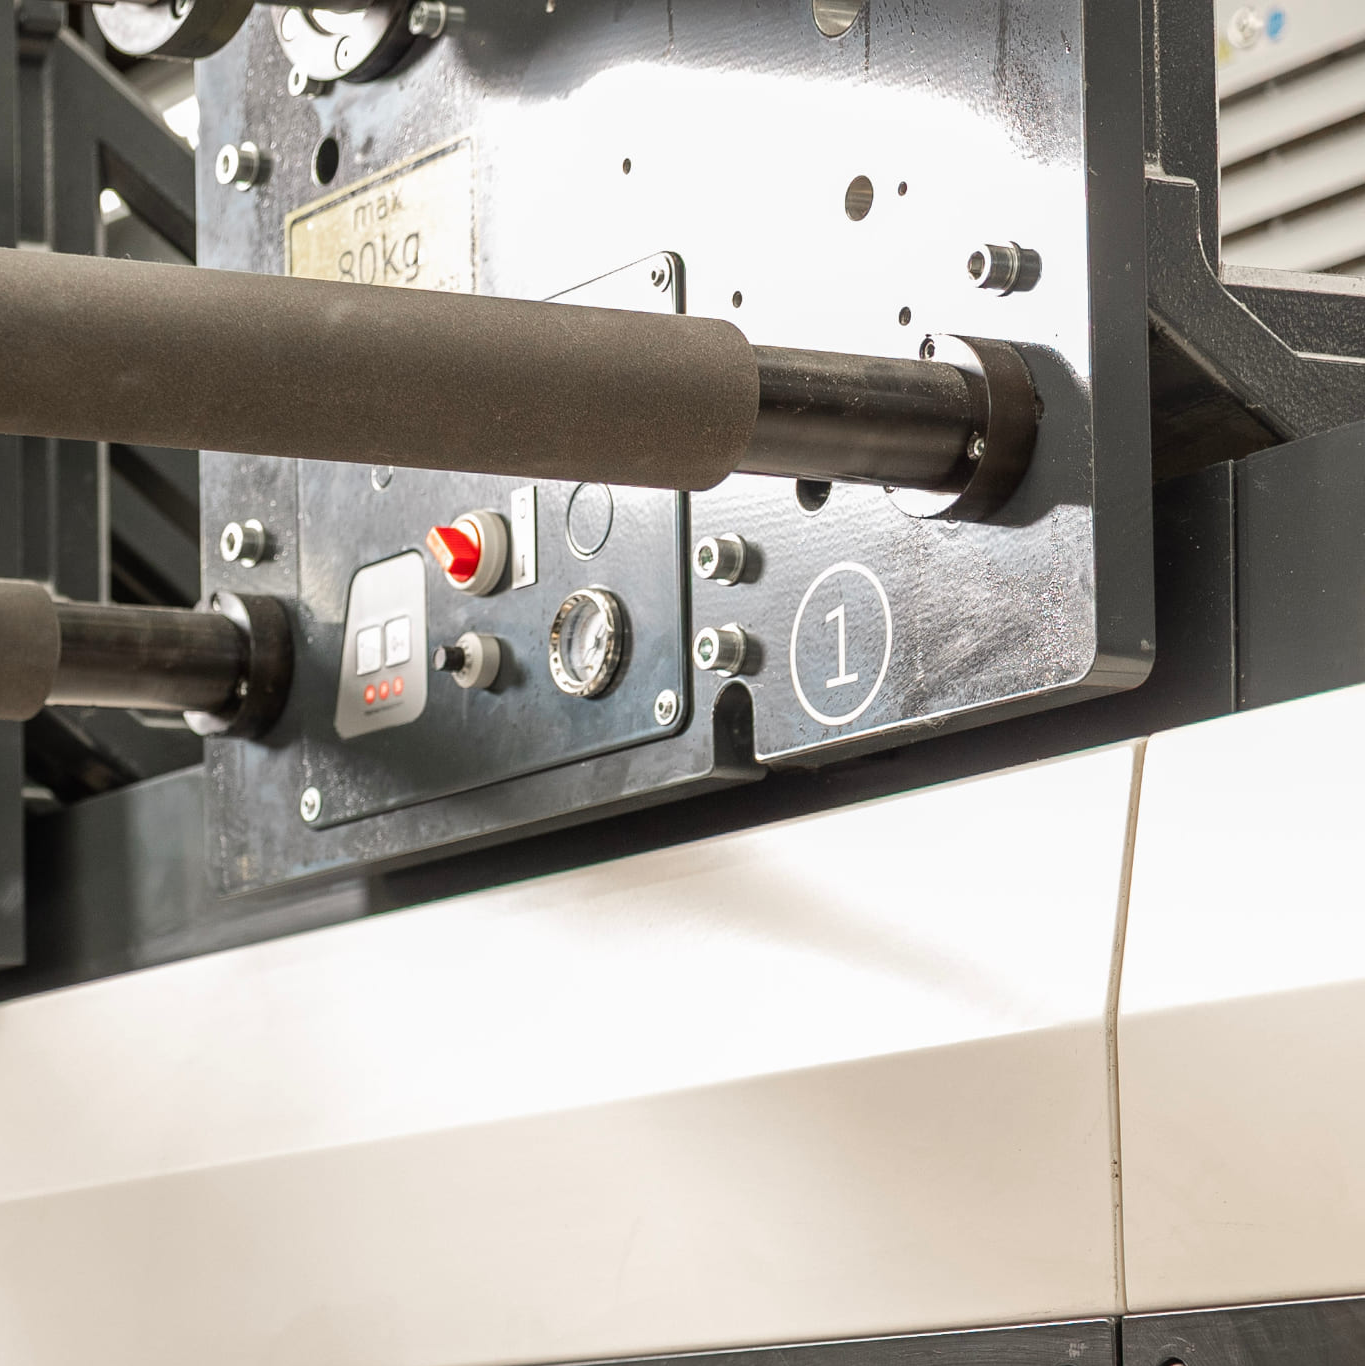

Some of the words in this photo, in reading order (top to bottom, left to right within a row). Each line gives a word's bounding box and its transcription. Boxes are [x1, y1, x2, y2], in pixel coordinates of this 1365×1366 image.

[353, 187, 403, 231] max
[338, 232, 420, 285] 80kg
[825, 603, 859, 689] 1
